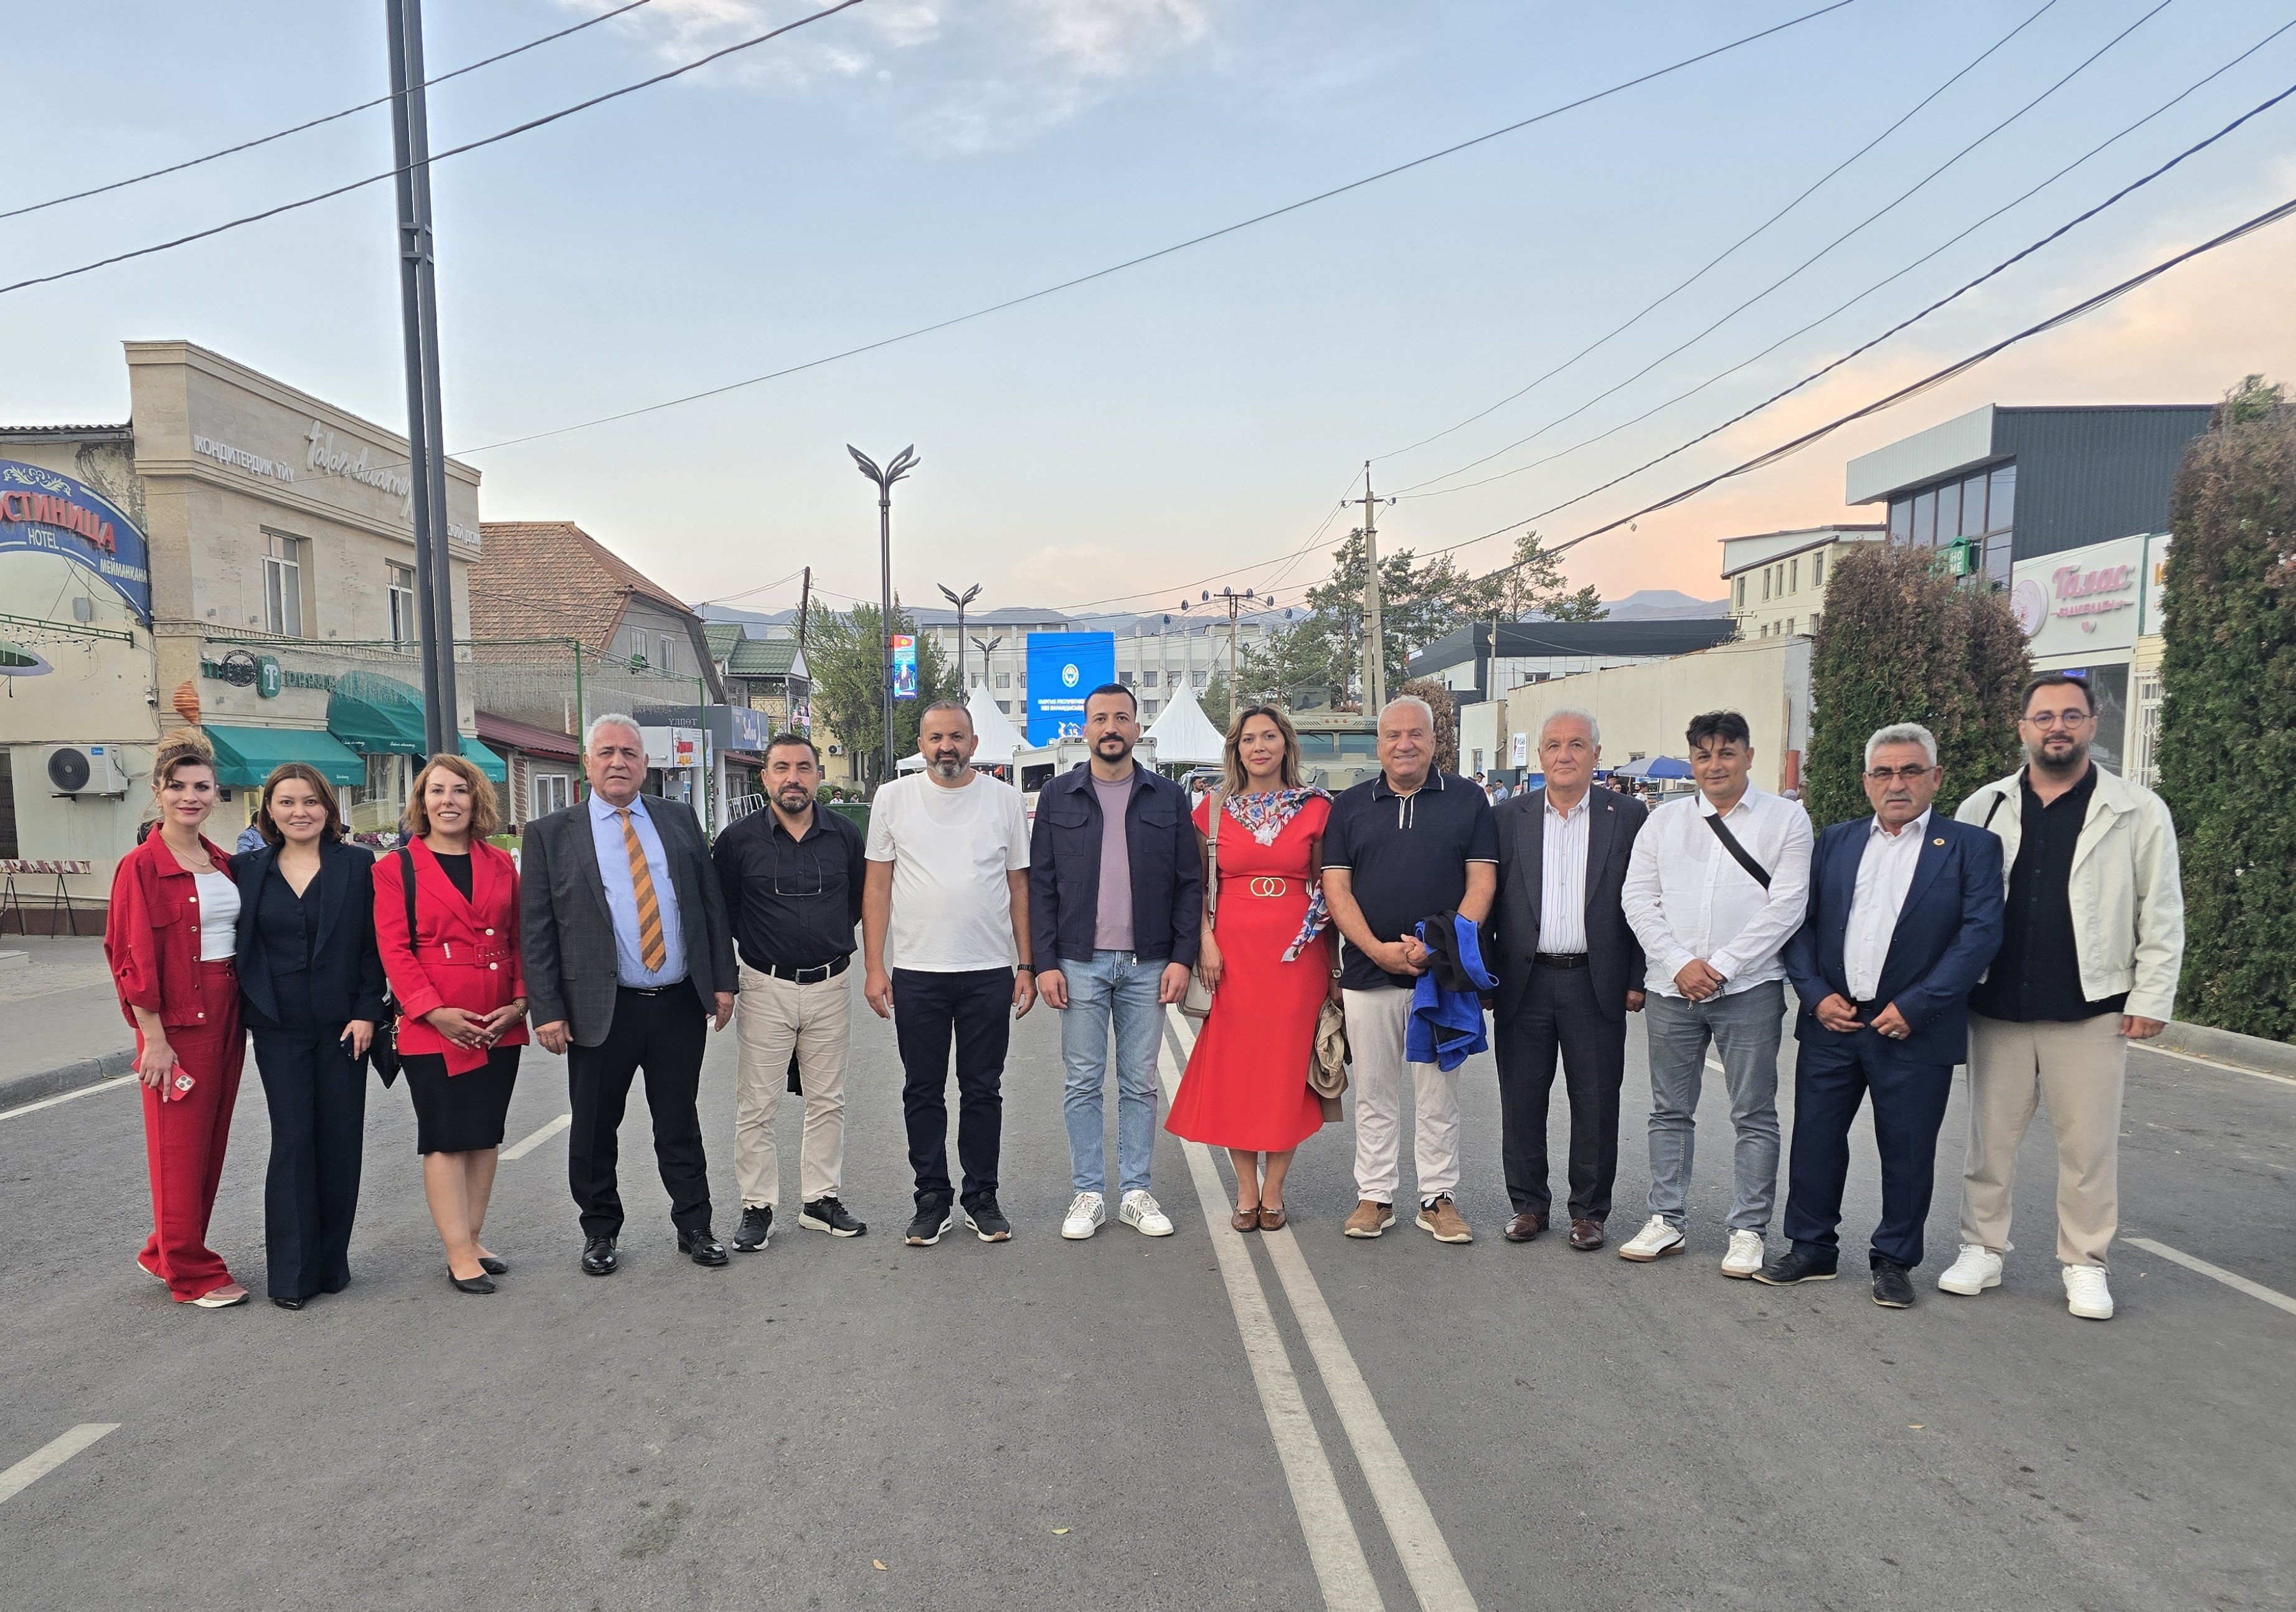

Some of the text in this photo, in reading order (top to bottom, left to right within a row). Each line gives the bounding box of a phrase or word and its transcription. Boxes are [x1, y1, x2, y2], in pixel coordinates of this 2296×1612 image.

[194, 434, 273, 476] КОНДИТЕРДИК
[27, 528, 60, 550] HOTEL
[100, 556, 148, 583] МЕЙМАНКАНА
[2052, 564, 2135, 600] Талас
